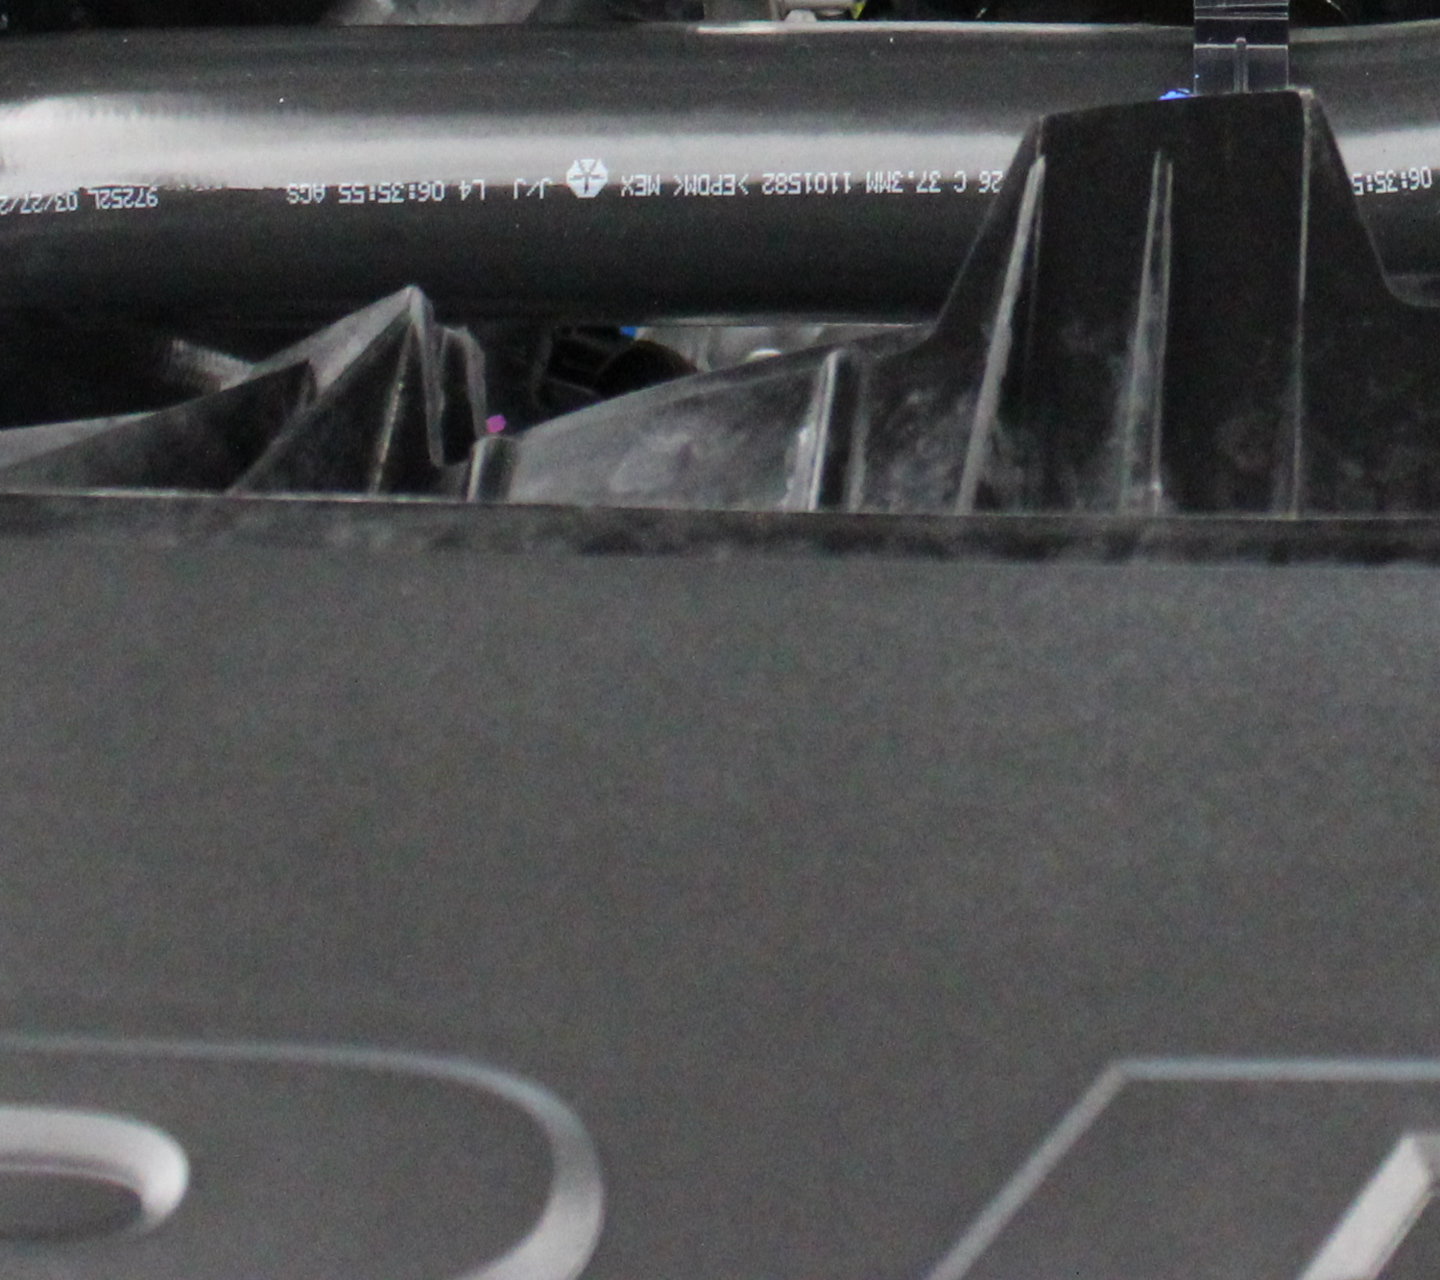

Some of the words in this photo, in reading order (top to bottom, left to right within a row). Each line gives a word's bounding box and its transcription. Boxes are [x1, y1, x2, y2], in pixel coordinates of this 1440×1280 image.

[339, 181, 445, 203] 06:35:55
[459, 180, 486, 201] L4
[621, 175, 661, 197] MEX
[762, 172, 853, 196] 1101582
[866, 170, 942, 194] 37.3MM
[953, 171, 966, 194] C
[89, 186, 159, 210] 97252L
[287, 183, 326, 204] AGS
